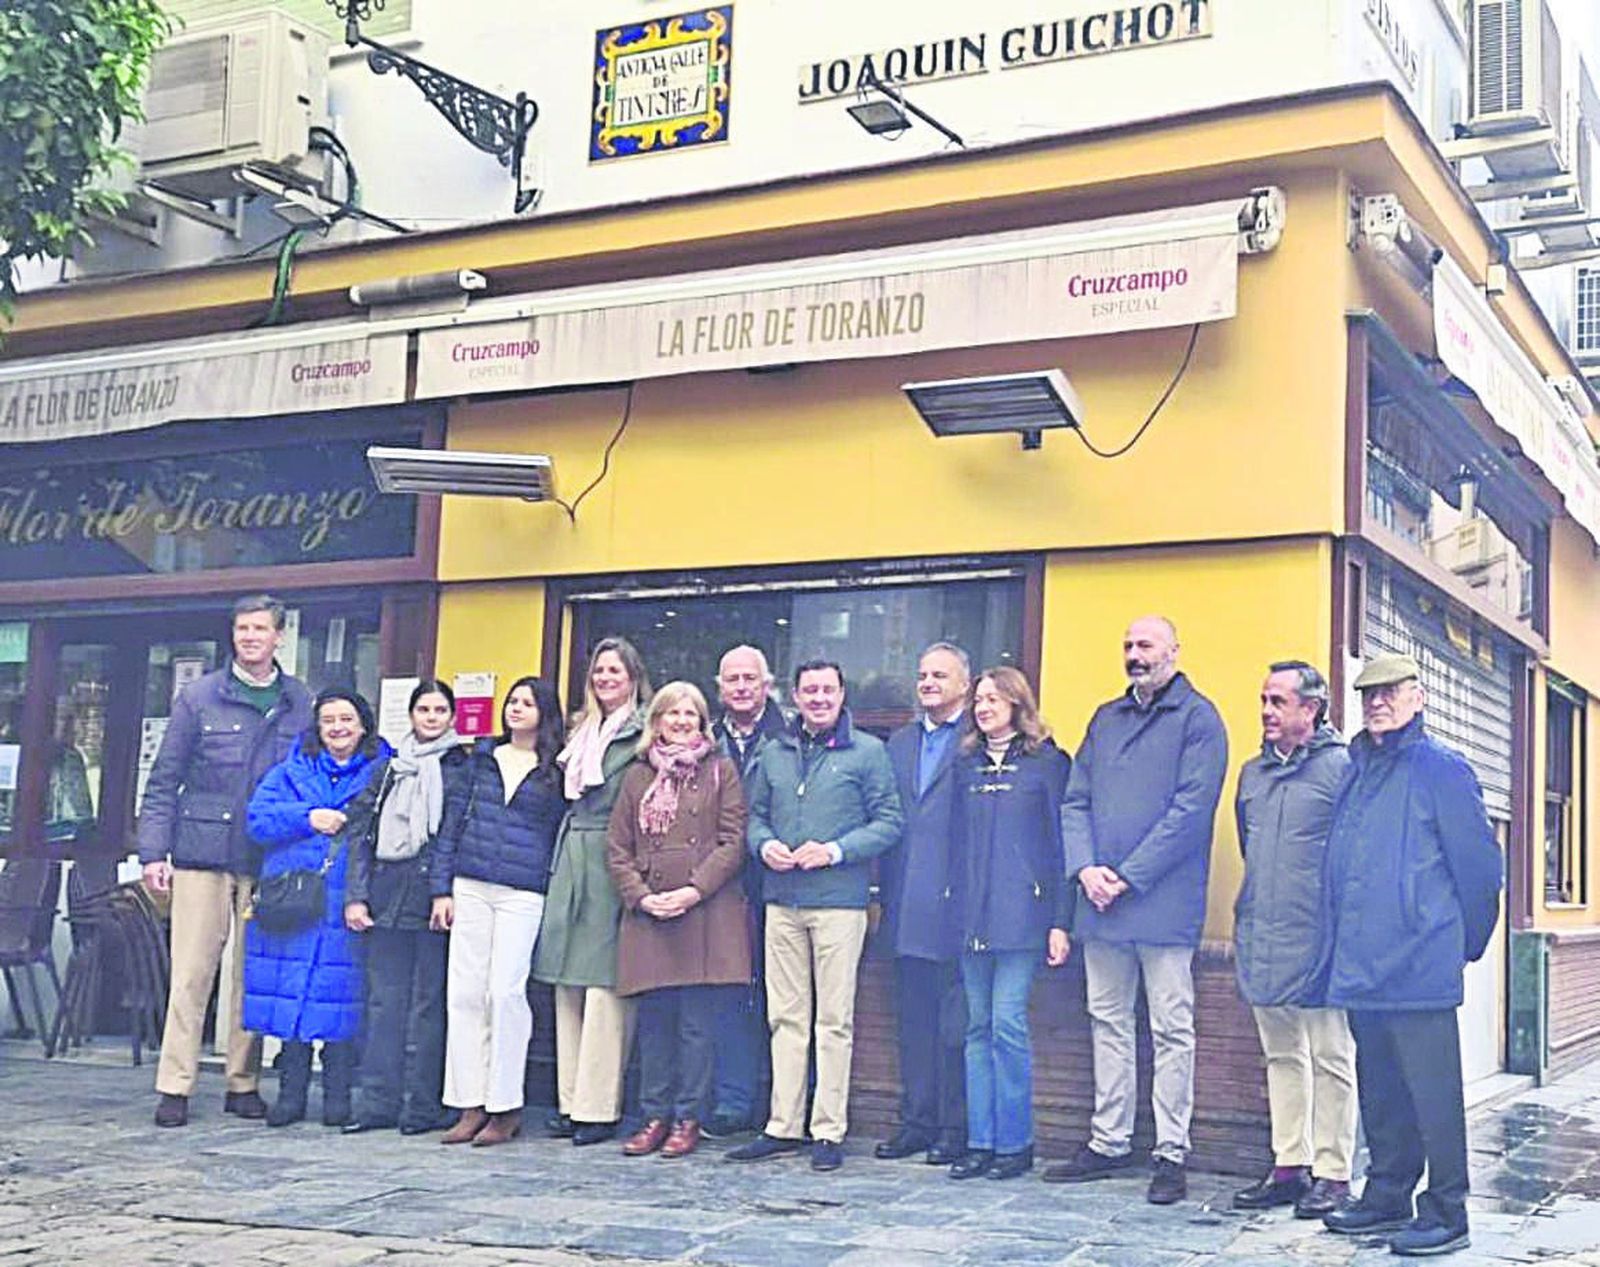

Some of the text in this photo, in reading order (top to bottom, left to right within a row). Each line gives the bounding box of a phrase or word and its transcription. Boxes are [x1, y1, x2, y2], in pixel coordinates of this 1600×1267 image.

[798, 0, 1208, 97] JOAQUIN GUICHOT
[653, 75, 668, 88] DE
[1068, 268, 1188, 298] Cruzcampo
[1092, 298, 1161, 317] ESPECIAL
[656, 292, 925, 358] LA FLOR DE TORANZO
[452, 339, 540, 362] Cruzcampo
[291, 358, 371, 383] Cruzcampo
[25, 391, 68, 427] FLOR
[74, 388, 99, 421] DE
[104, 376, 179, 418] TORANZO
[83, 481, 140, 537] de
[154, 472, 366, 550] Toranzo
